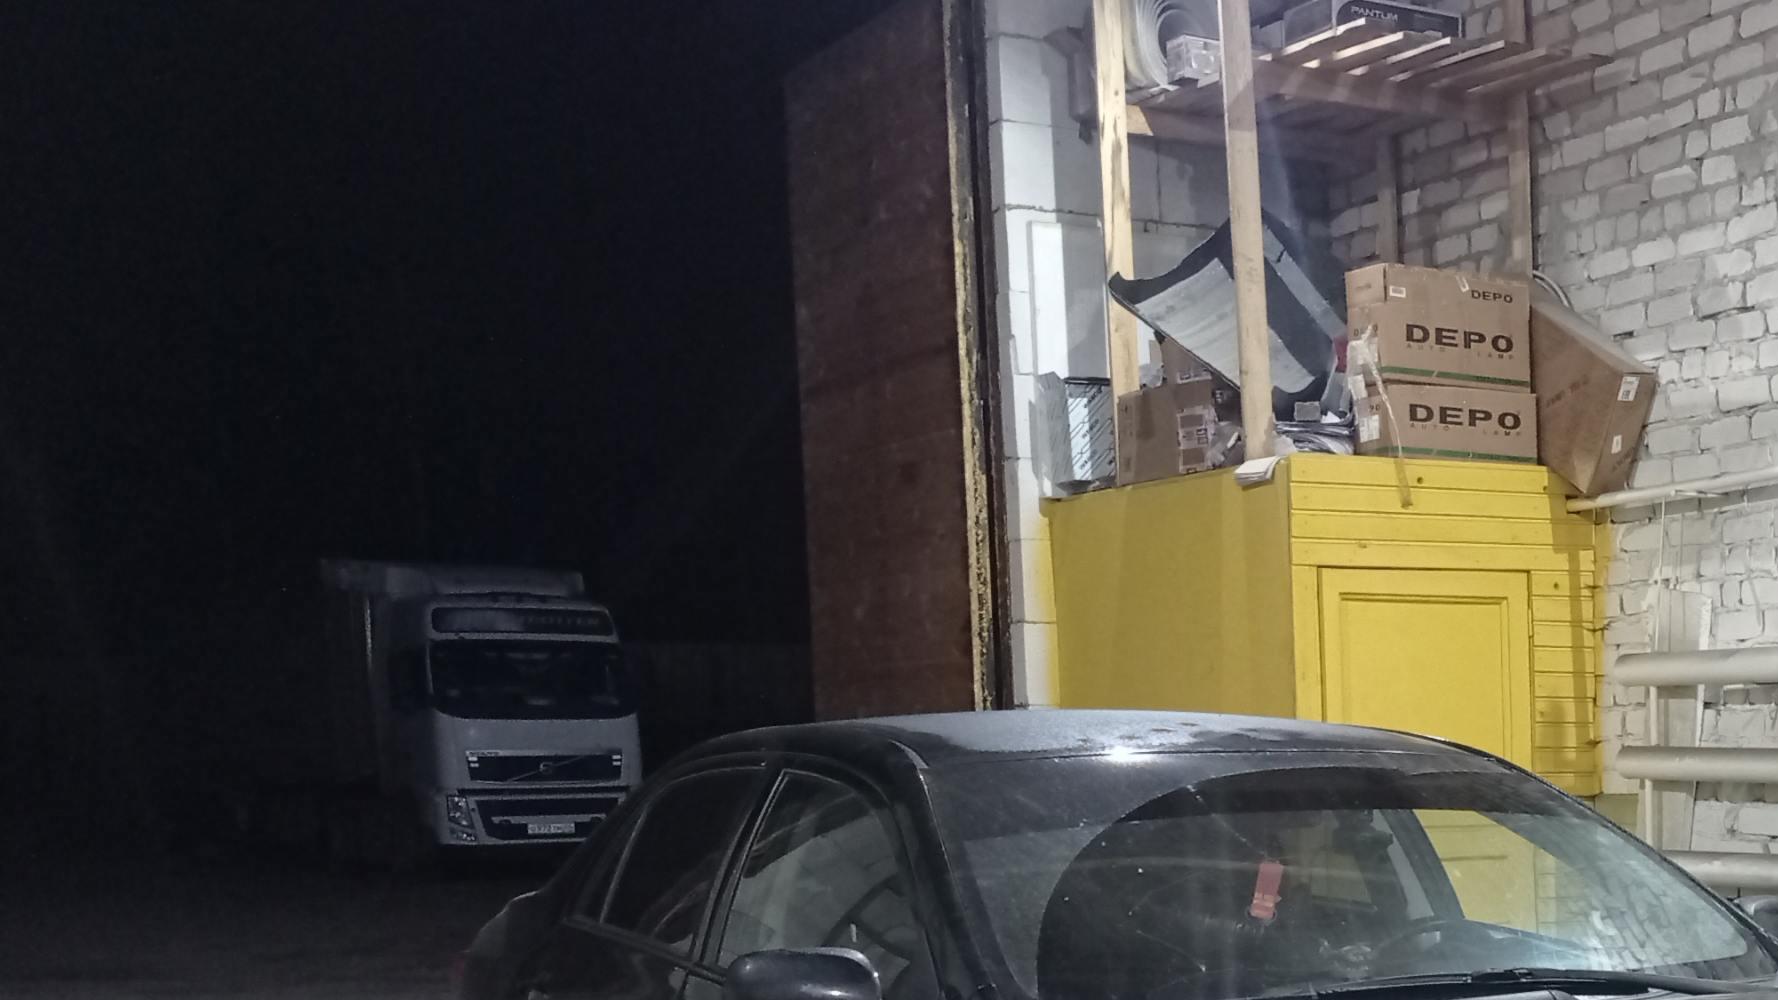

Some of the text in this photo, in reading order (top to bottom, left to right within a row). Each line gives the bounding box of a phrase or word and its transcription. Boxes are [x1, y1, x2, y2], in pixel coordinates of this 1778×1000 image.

[1350, 6, 1399, 21] PANTUM
[1471, 289, 1513, 304] DEPO
[1406, 323, 1514, 353] DEPO
[1409, 403, 1521, 430] DEPO
